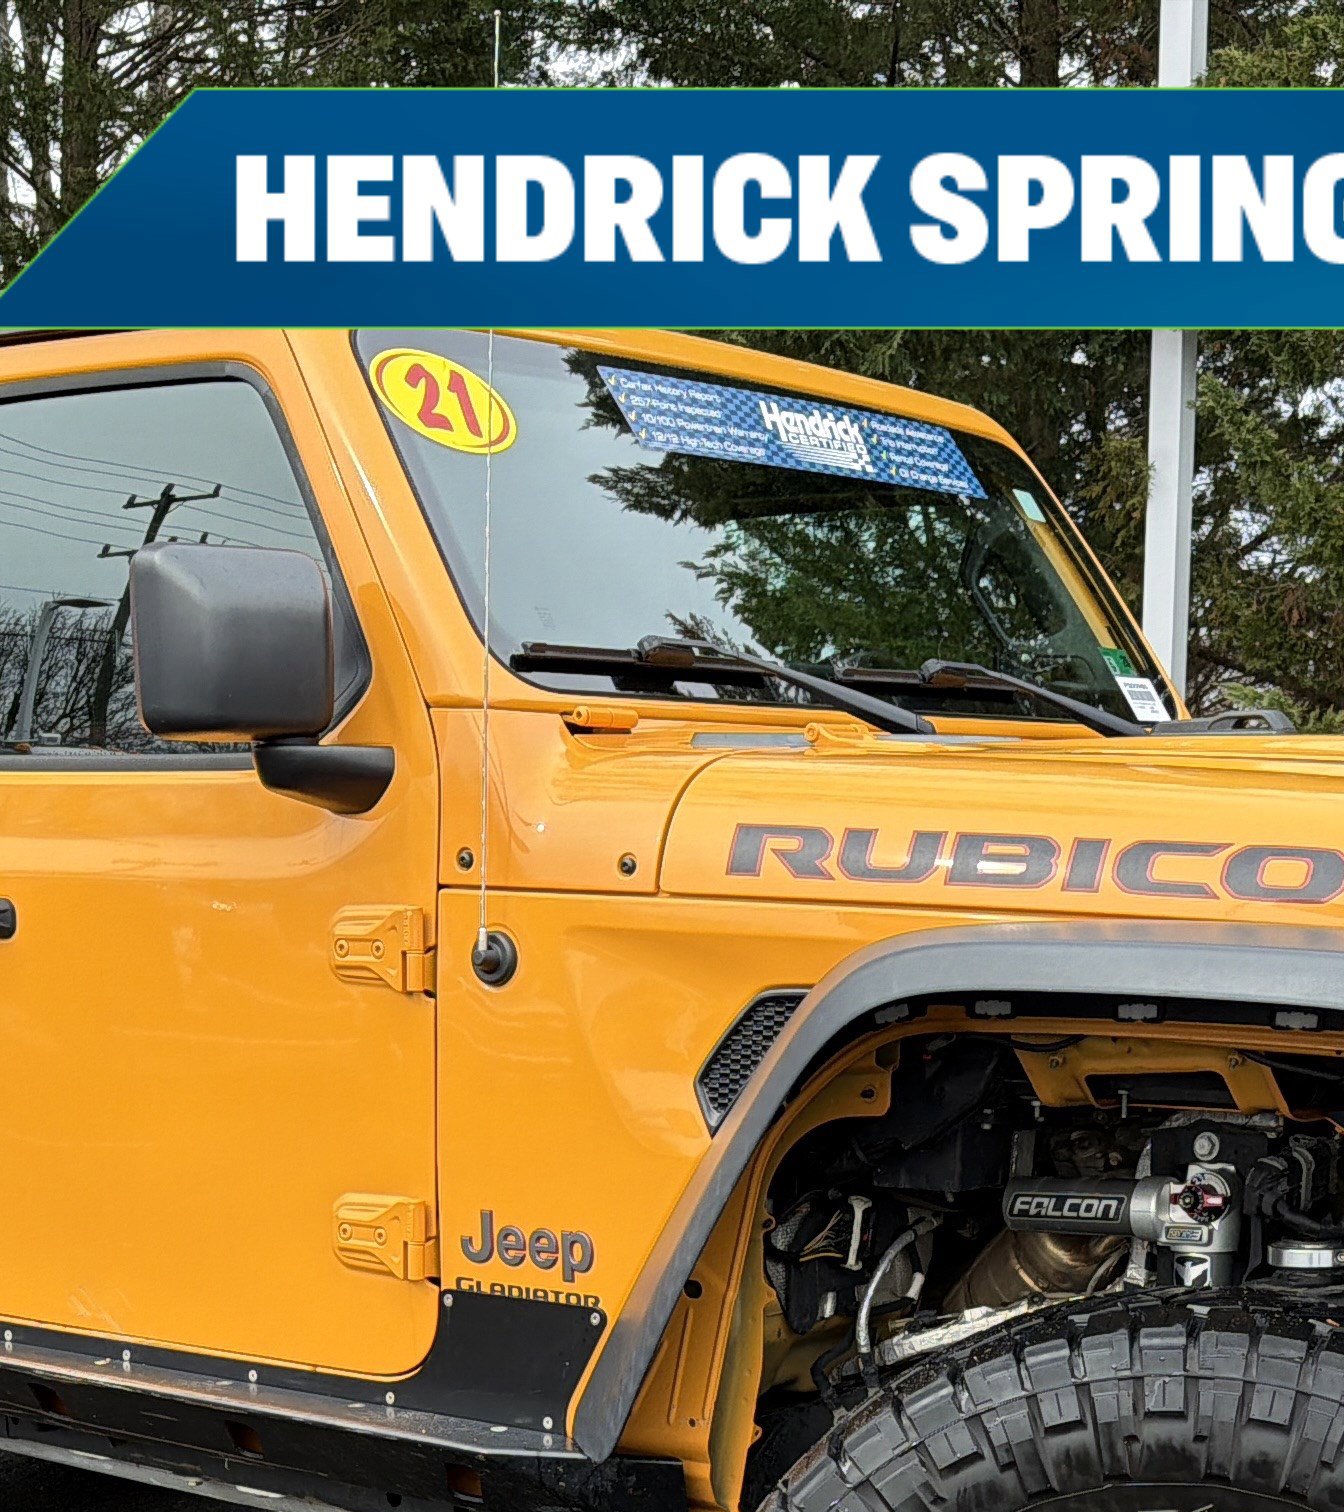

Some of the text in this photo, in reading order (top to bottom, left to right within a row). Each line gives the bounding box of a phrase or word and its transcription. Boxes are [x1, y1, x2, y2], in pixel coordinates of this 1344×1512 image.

[405, 363, 481, 436] 21
[758, 400, 864, 444] Hendrick
[787, 433, 867, 454] CERTIFIED
[1012, 1195, 1119, 1220] FALCON
[460, 1208, 595, 1283] Jeep
[455, 1276, 601, 1308] GLADIATOR
